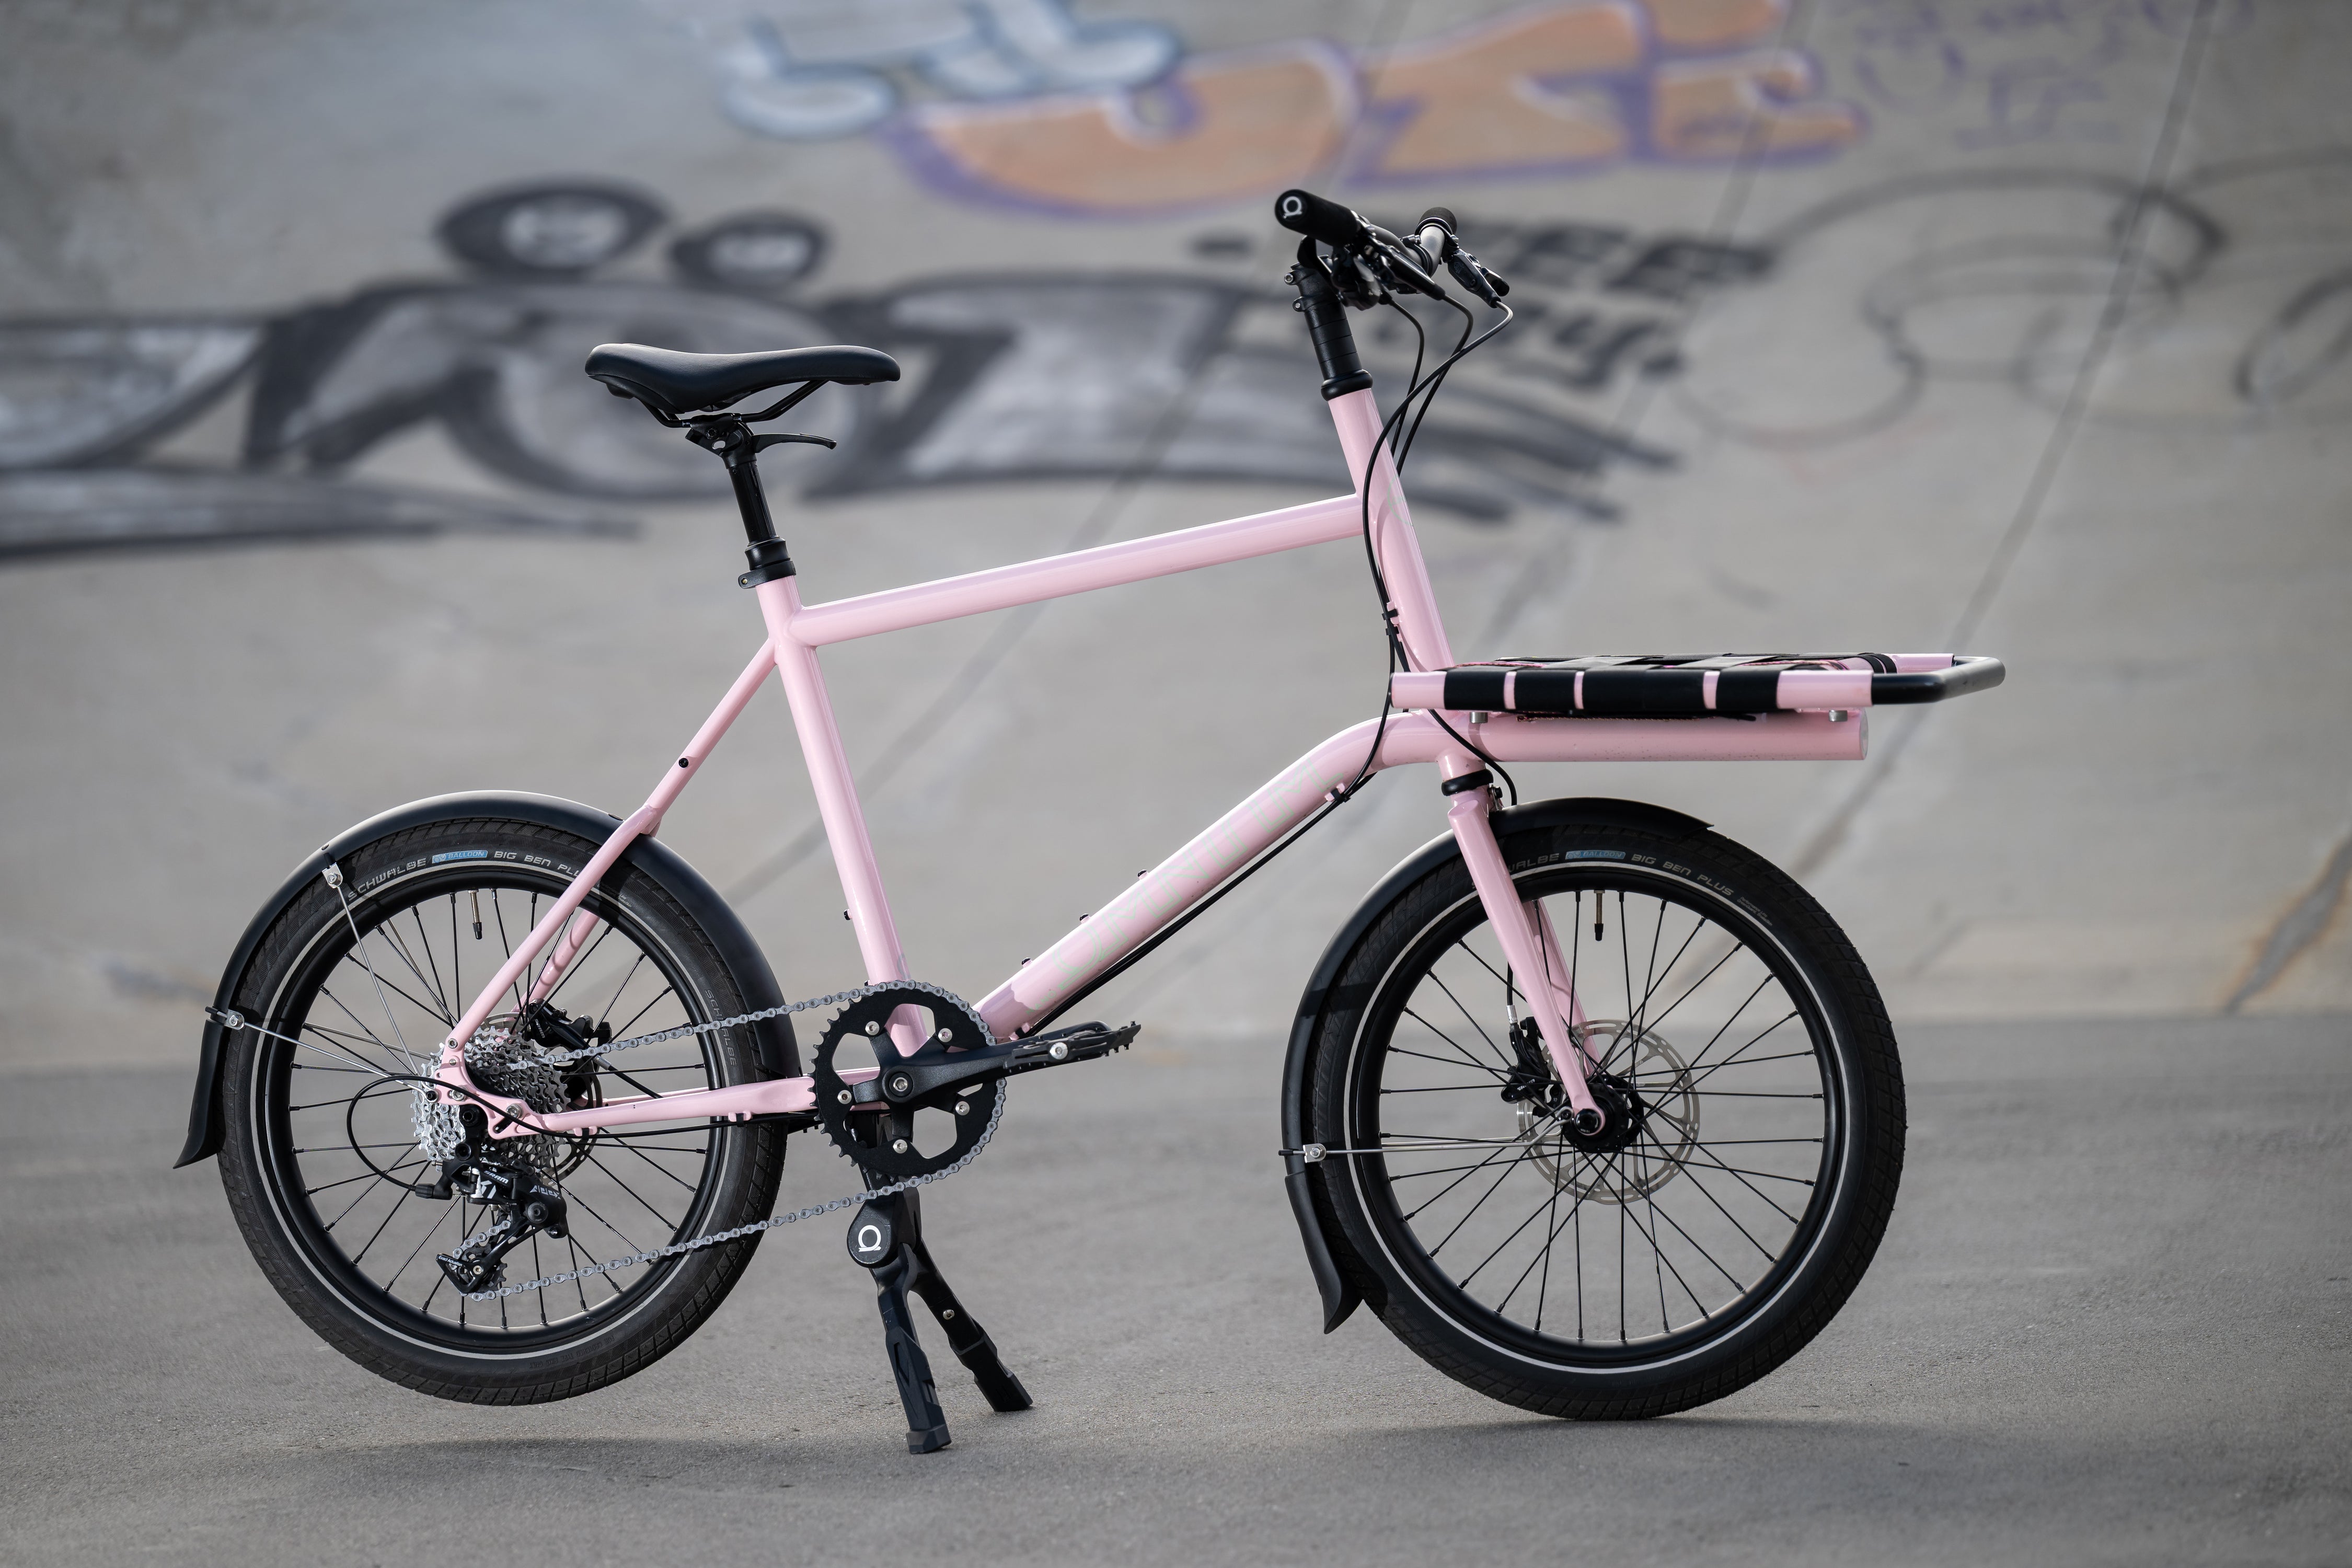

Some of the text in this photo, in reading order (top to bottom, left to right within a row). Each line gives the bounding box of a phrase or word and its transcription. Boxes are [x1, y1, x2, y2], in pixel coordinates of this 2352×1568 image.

[349, 858, 426, 901] SCHWALBE
[494, 851, 517, 859] BIG
[524, 855, 551, 867] BEN
[1631, 854, 1656, 864] BIG
[1663, 861, 1692, 876] BEN
[1697, 874, 1735, 896] PLUS
[1025, 990, 1057, 1015] NANO
[535, 1019, 545, 1038] SRAM
[705, 989, 737, 1066] SCHALBE
[483, 1170, 509, 1184] SRAM
[447, 1259, 463, 1267] Actuation
